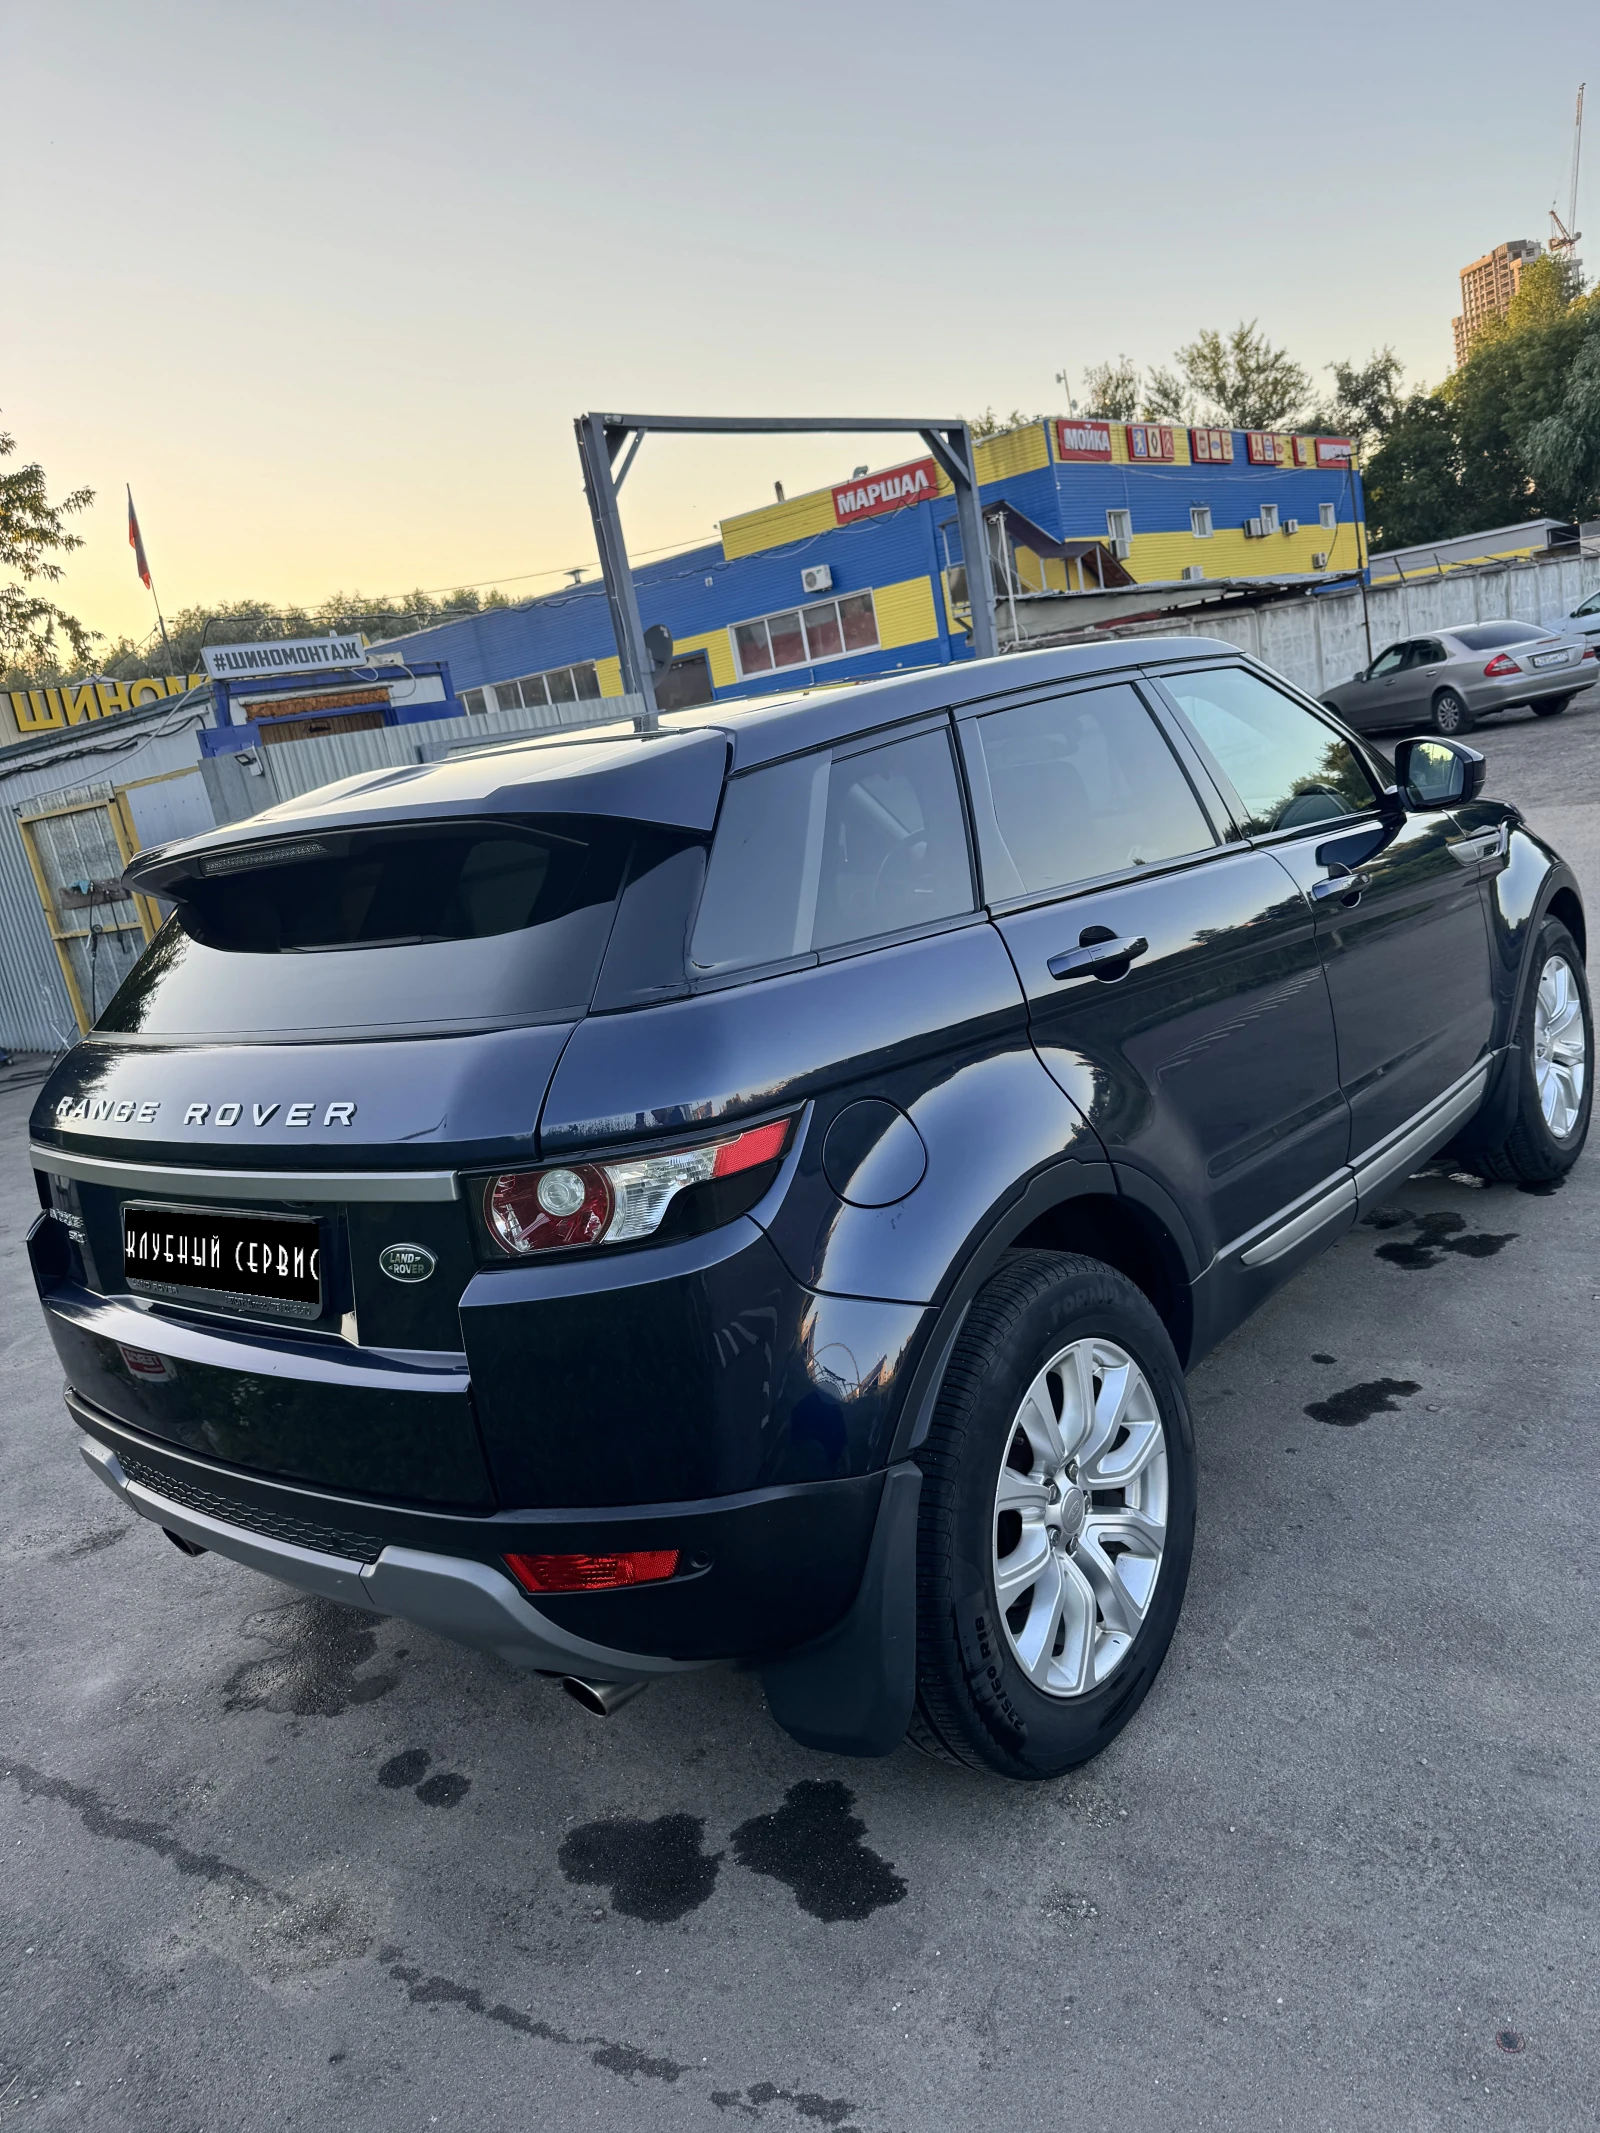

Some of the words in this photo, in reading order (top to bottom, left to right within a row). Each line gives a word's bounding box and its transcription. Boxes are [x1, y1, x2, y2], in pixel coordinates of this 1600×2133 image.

[1063, 424, 1111, 451] МОЙКА
[836, 469, 929, 515] МАРШАЛ
[213, 642, 360, 671] #ШИНОМОНТАЖ
[55, 1096, 160, 1123] RANGE
[183, 1102, 357, 1127] ROVER
[390, 1253, 415, 1263] LAND
[393, 1264, 424, 1274] ROVER
